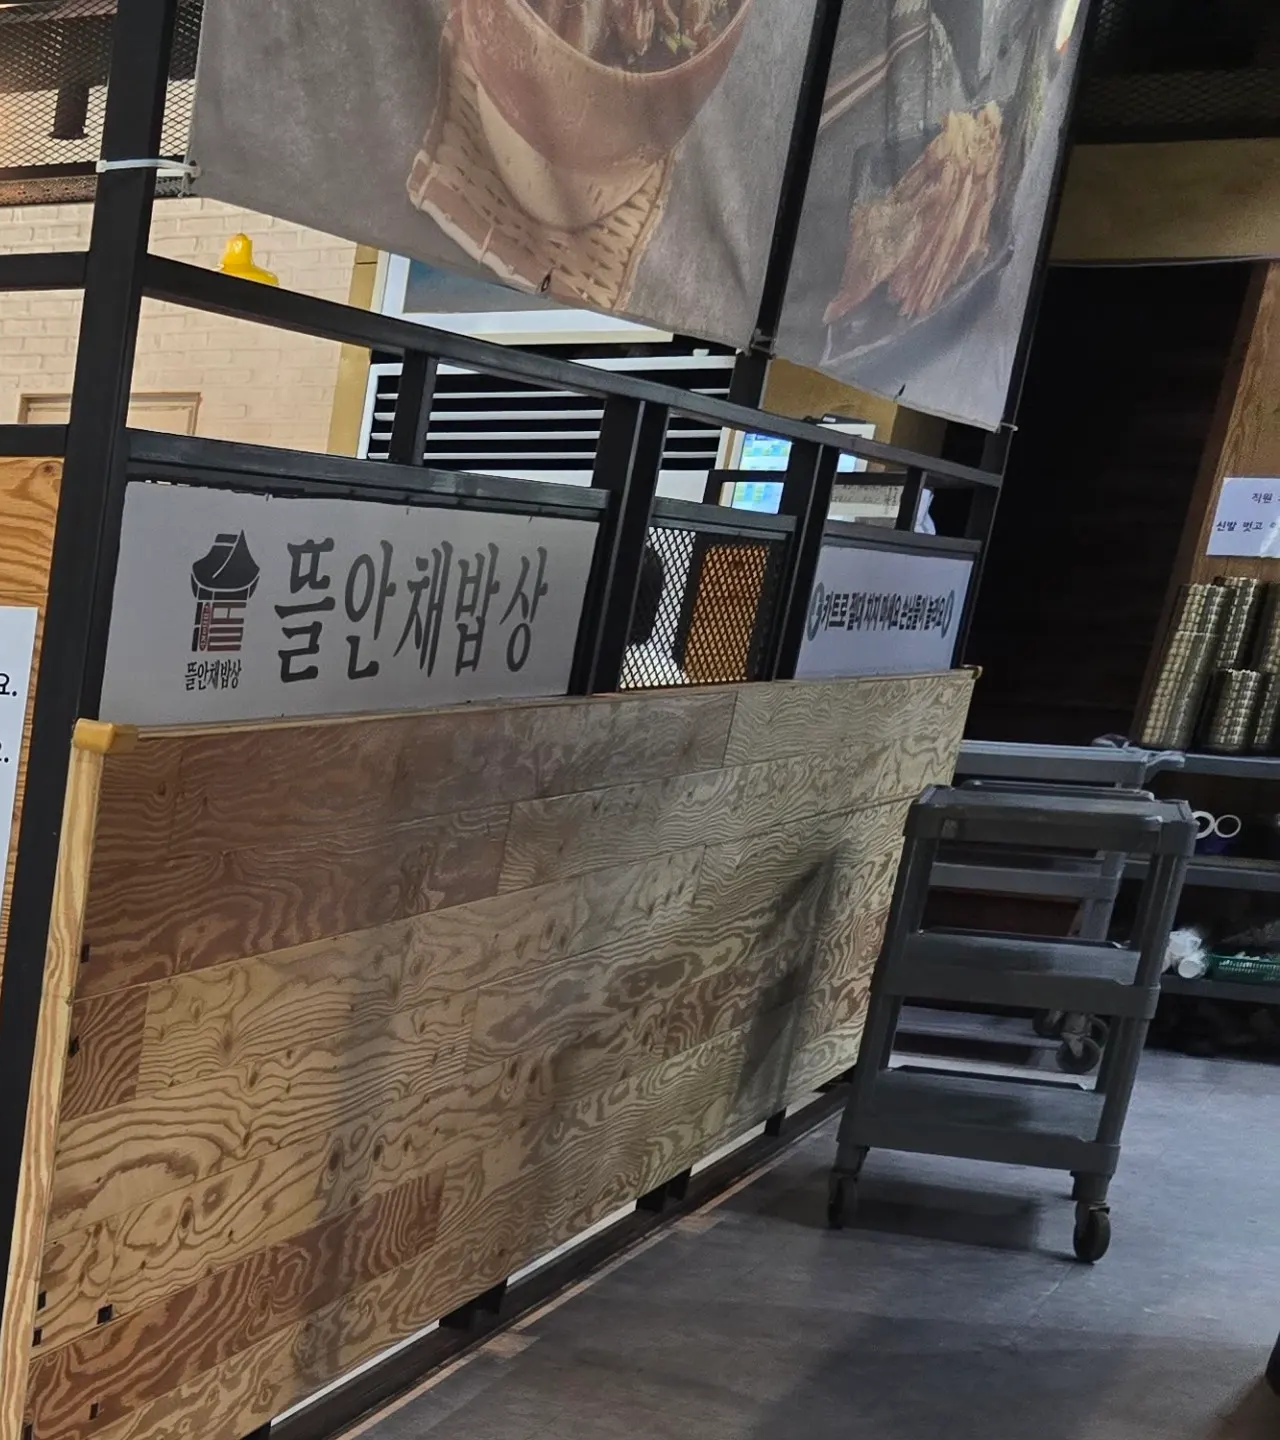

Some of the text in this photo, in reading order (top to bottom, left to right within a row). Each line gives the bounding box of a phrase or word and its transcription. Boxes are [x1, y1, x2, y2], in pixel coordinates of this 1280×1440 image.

[1251, 492, 1274, 504] 직원
[1216, 520, 1238, 532] 신발
[273, 537, 549, 684] 뜰안채밥상
[184, 658, 242, 692] 뜰안채밥상
